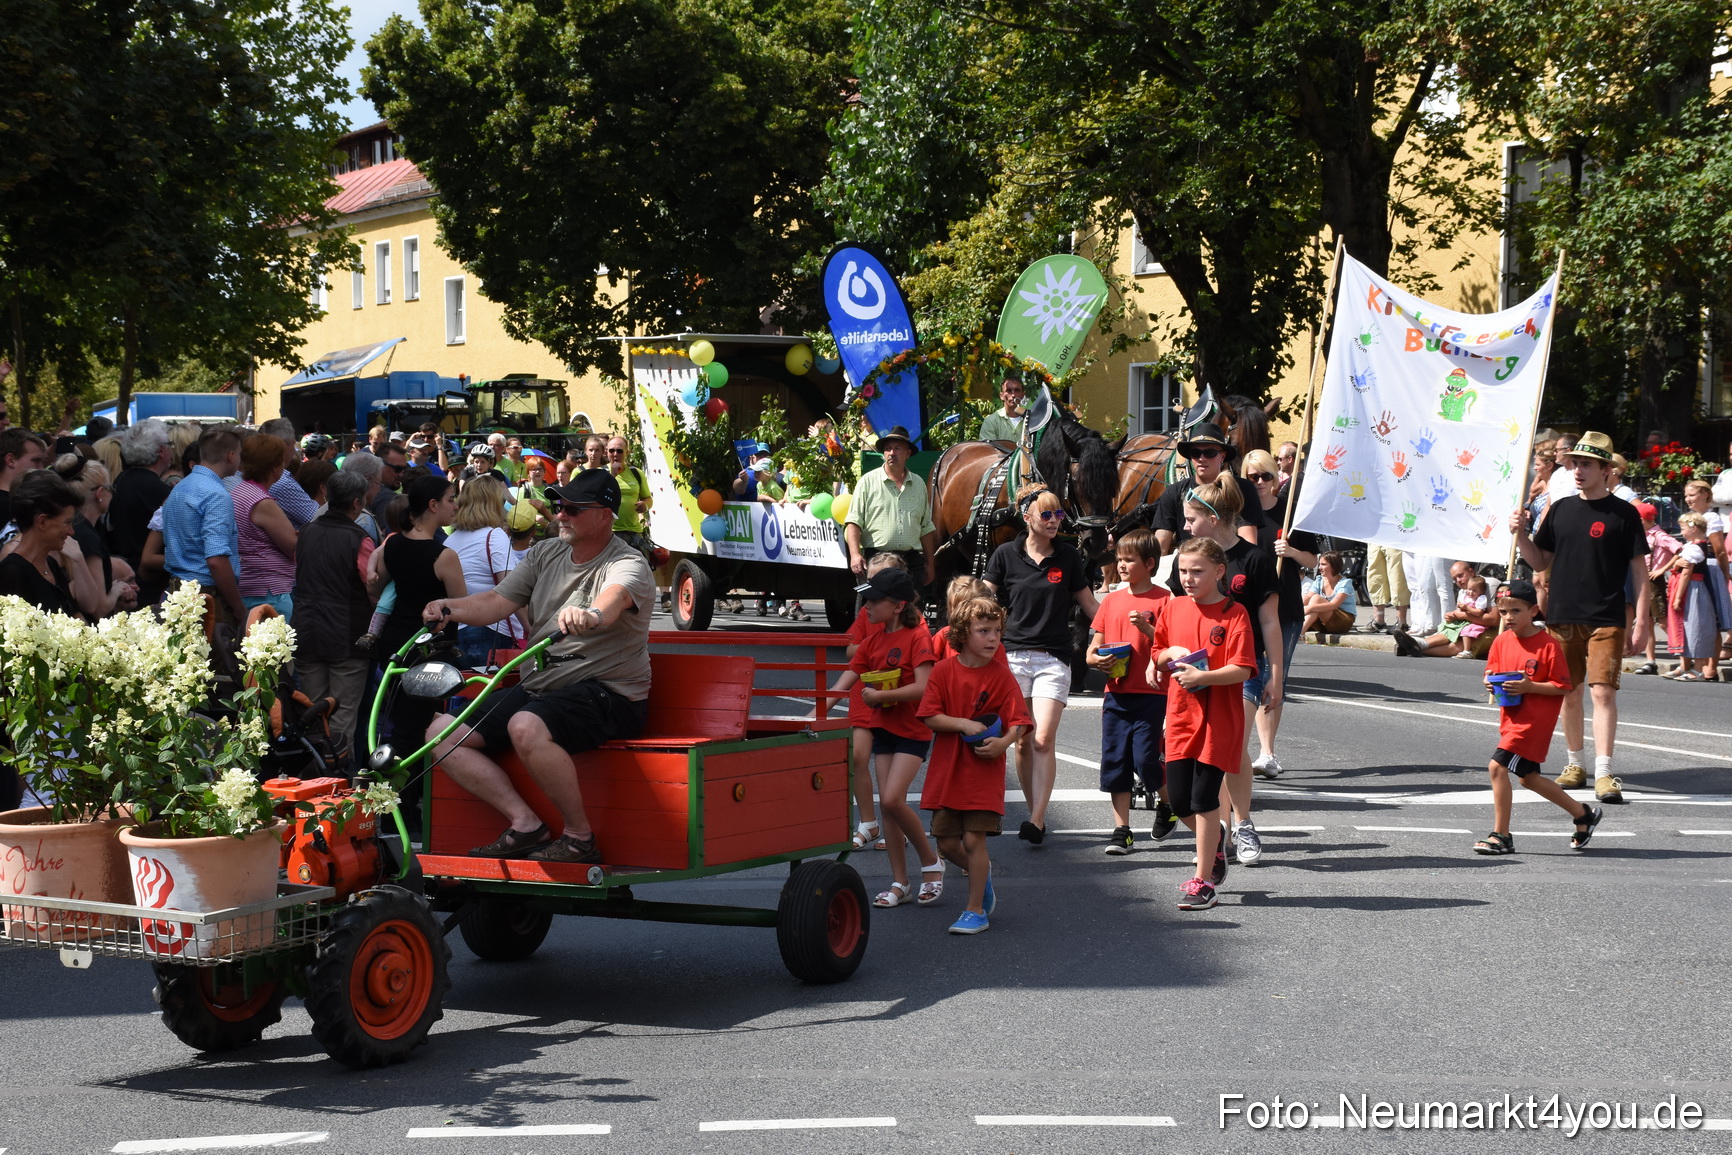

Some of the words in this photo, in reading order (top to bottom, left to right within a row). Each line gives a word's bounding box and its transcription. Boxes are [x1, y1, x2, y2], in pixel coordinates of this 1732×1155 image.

[728, 509, 750, 538] DAV
[784, 519, 839, 542] Lebenshilfe
[786, 544, 812, 557] Neumarkt
[6, 838, 64, 894] Jahre
